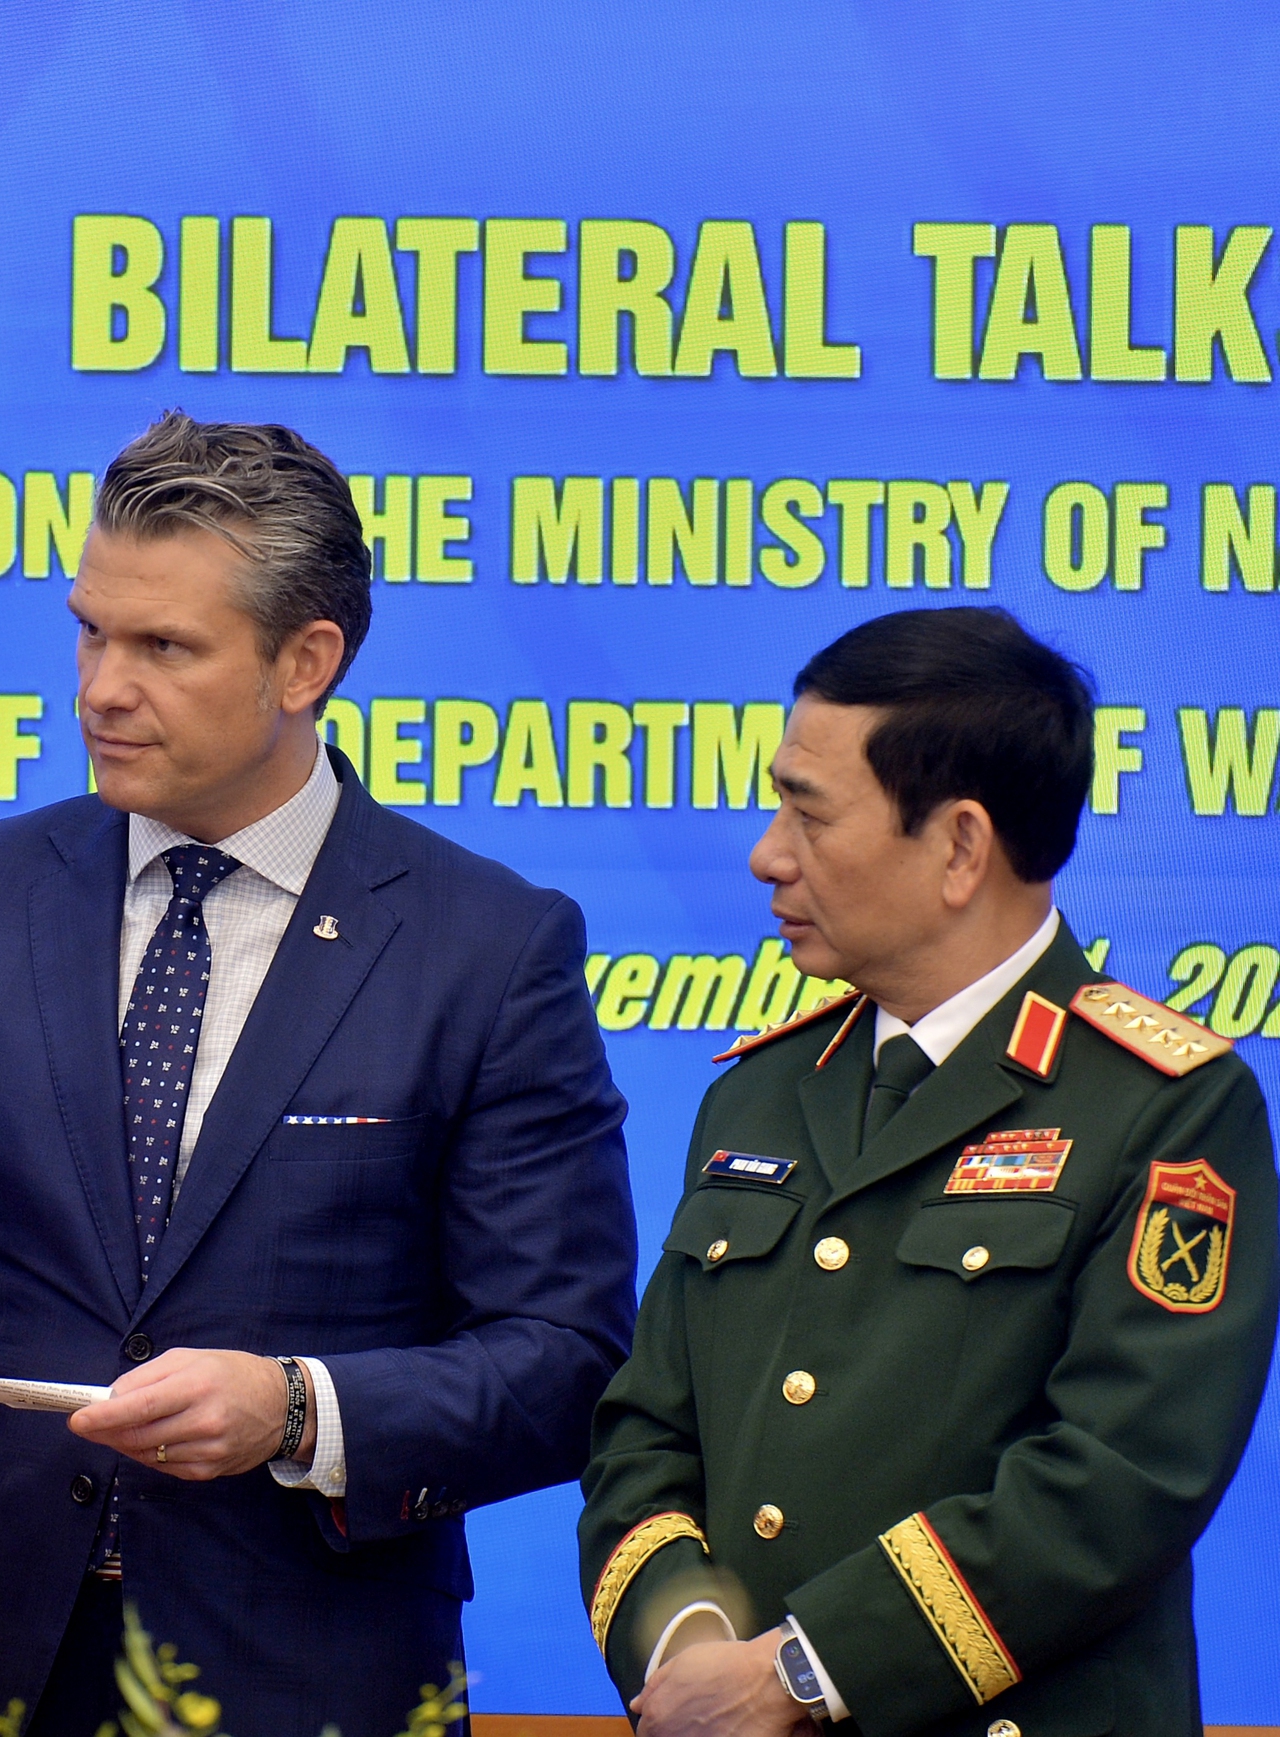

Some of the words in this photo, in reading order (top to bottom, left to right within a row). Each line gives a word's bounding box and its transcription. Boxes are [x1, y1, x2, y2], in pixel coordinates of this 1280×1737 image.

[72, 216, 860, 379] BILATERAL
[913, 224, 1274, 382] TALK
[349, 475, 473, 582] HE
[512, 478, 1008, 588] MINISTRY
[1045, 482, 1168, 591] OF
[1203, 484, 1280, 592] N
[316, 698, 785, 809] DEPARTM
[1093, 707, 1145, 814] F
[1179, 709, 1280, 815] W
